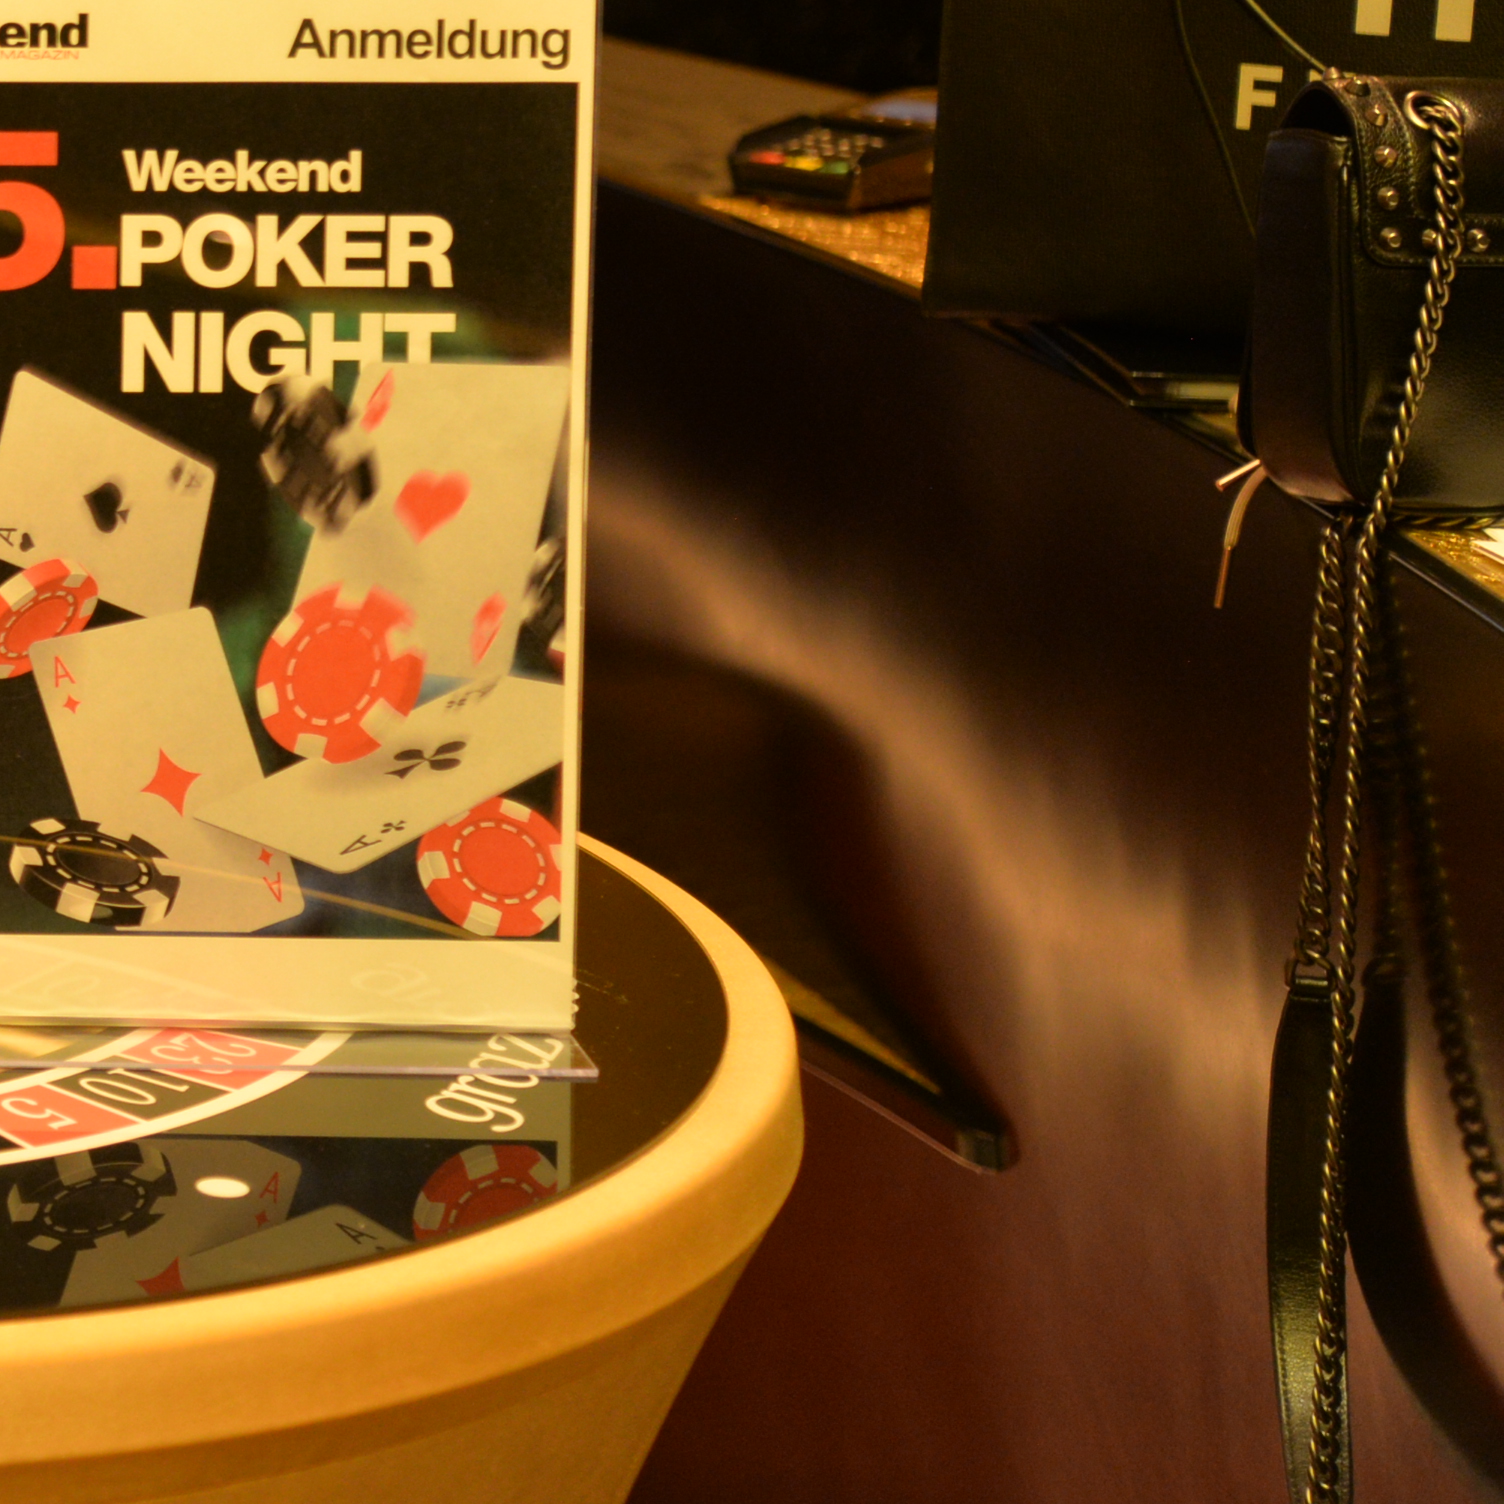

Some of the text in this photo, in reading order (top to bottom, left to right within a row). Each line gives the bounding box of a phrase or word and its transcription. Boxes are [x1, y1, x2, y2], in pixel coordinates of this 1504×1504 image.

[0, 50, 80, 61] MAGAZIN
[289, 18, 571, 70] Anmeldung
[122, 149, 363, 194] Weekend
[120, 212, 455, 290] POKER
[121, 310, 457, 395] NIGHT
[78, 1066, 191, 1106] 10
[0, 1092, 79, 1132] 5
